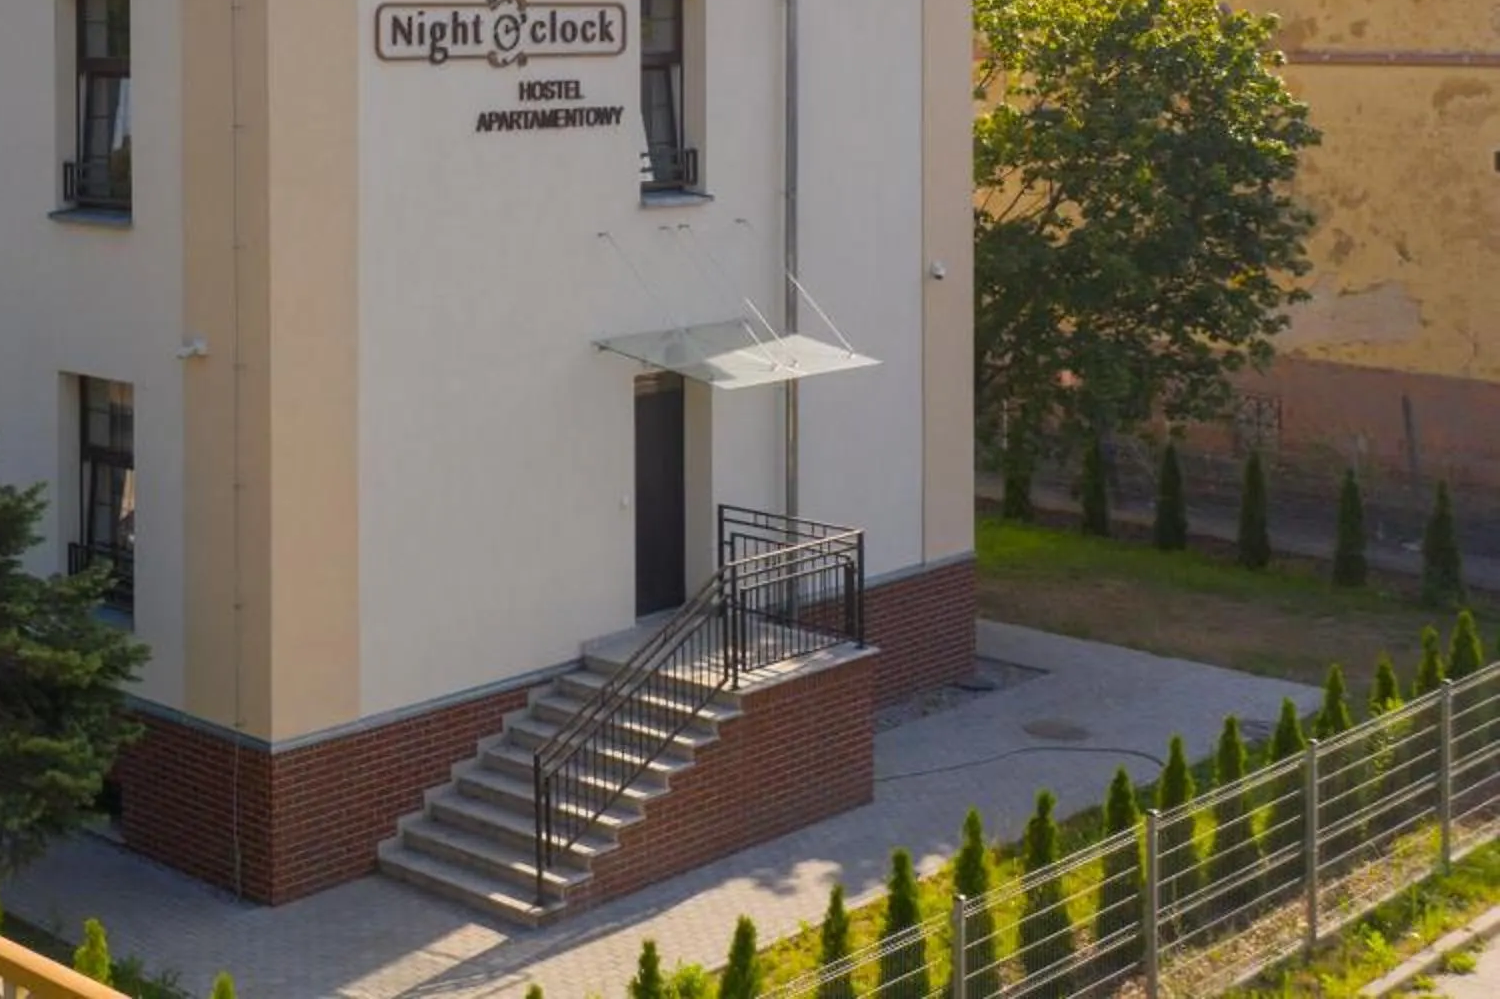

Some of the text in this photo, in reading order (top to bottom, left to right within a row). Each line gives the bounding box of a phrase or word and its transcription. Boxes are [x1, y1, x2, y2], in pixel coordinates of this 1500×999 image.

[391, 11, 483, 65] Night
[518, 80, 583, 101] HOSTEL
[476, 106, 624, 132] APARTAMENTOWY
